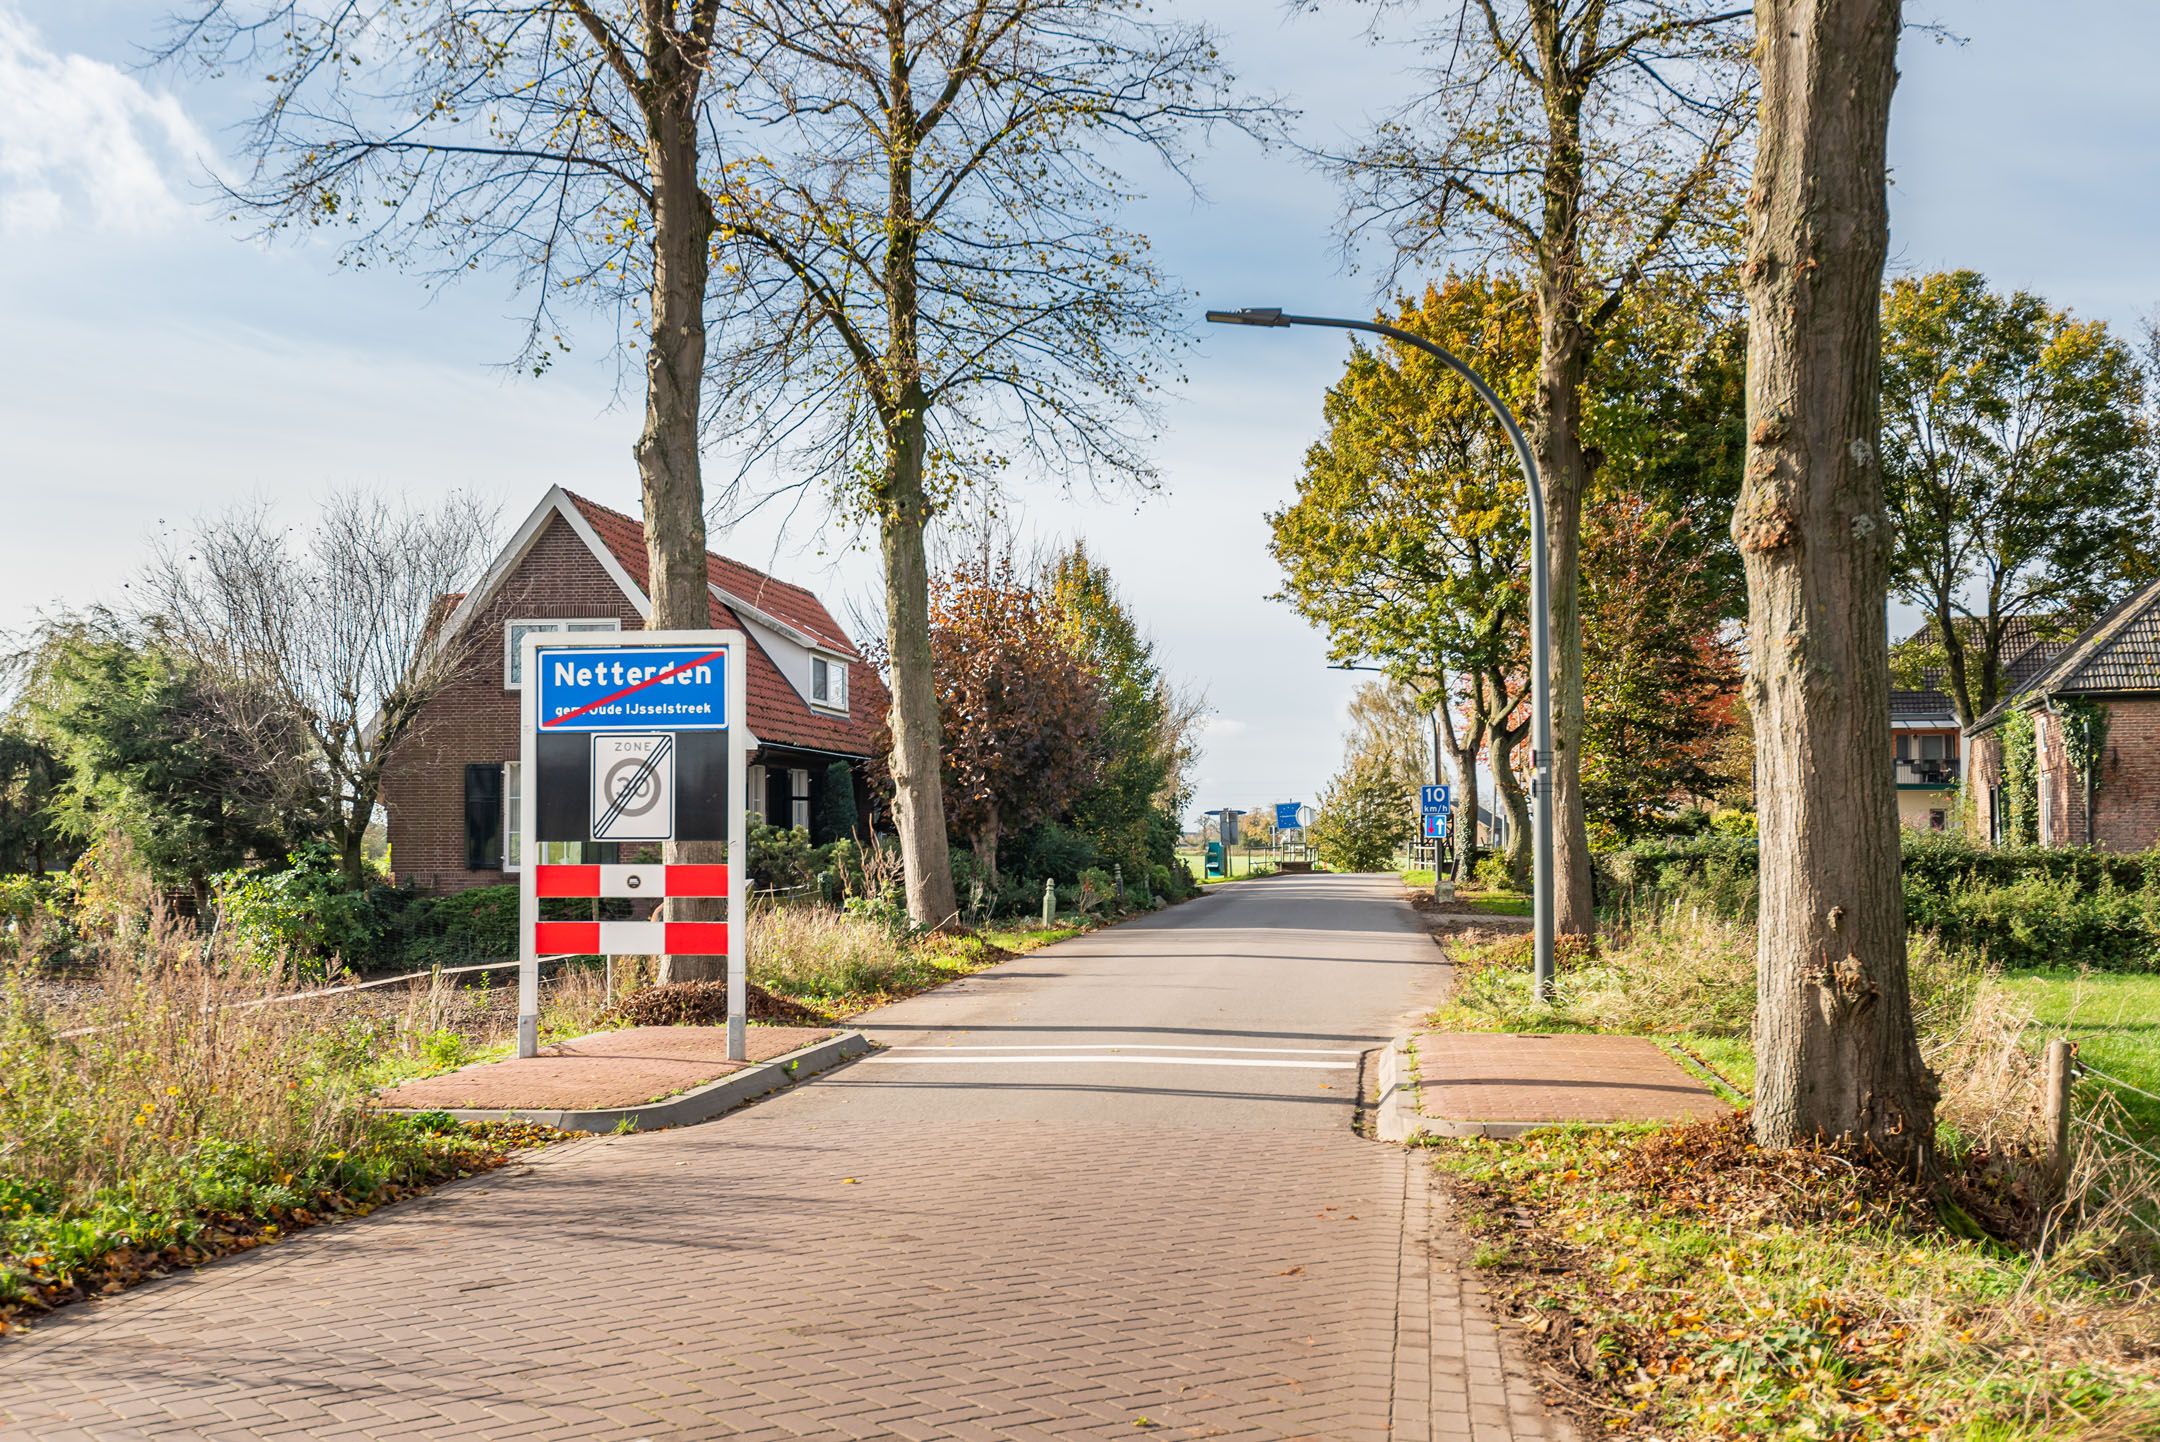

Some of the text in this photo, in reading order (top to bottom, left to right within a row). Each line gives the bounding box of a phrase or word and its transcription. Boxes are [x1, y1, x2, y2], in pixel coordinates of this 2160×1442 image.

[555, 661, 712, 687] Netterden
[589, 704, 623, 716] Oude
[626, 702, 712, 715] IJsselstreek
[614, 742, 652, 752] ZONE
[616, 776, 650, 798] 30
[1425, 787, 1446, 803] 10
[1424, 804, 1448, 813] km/h
